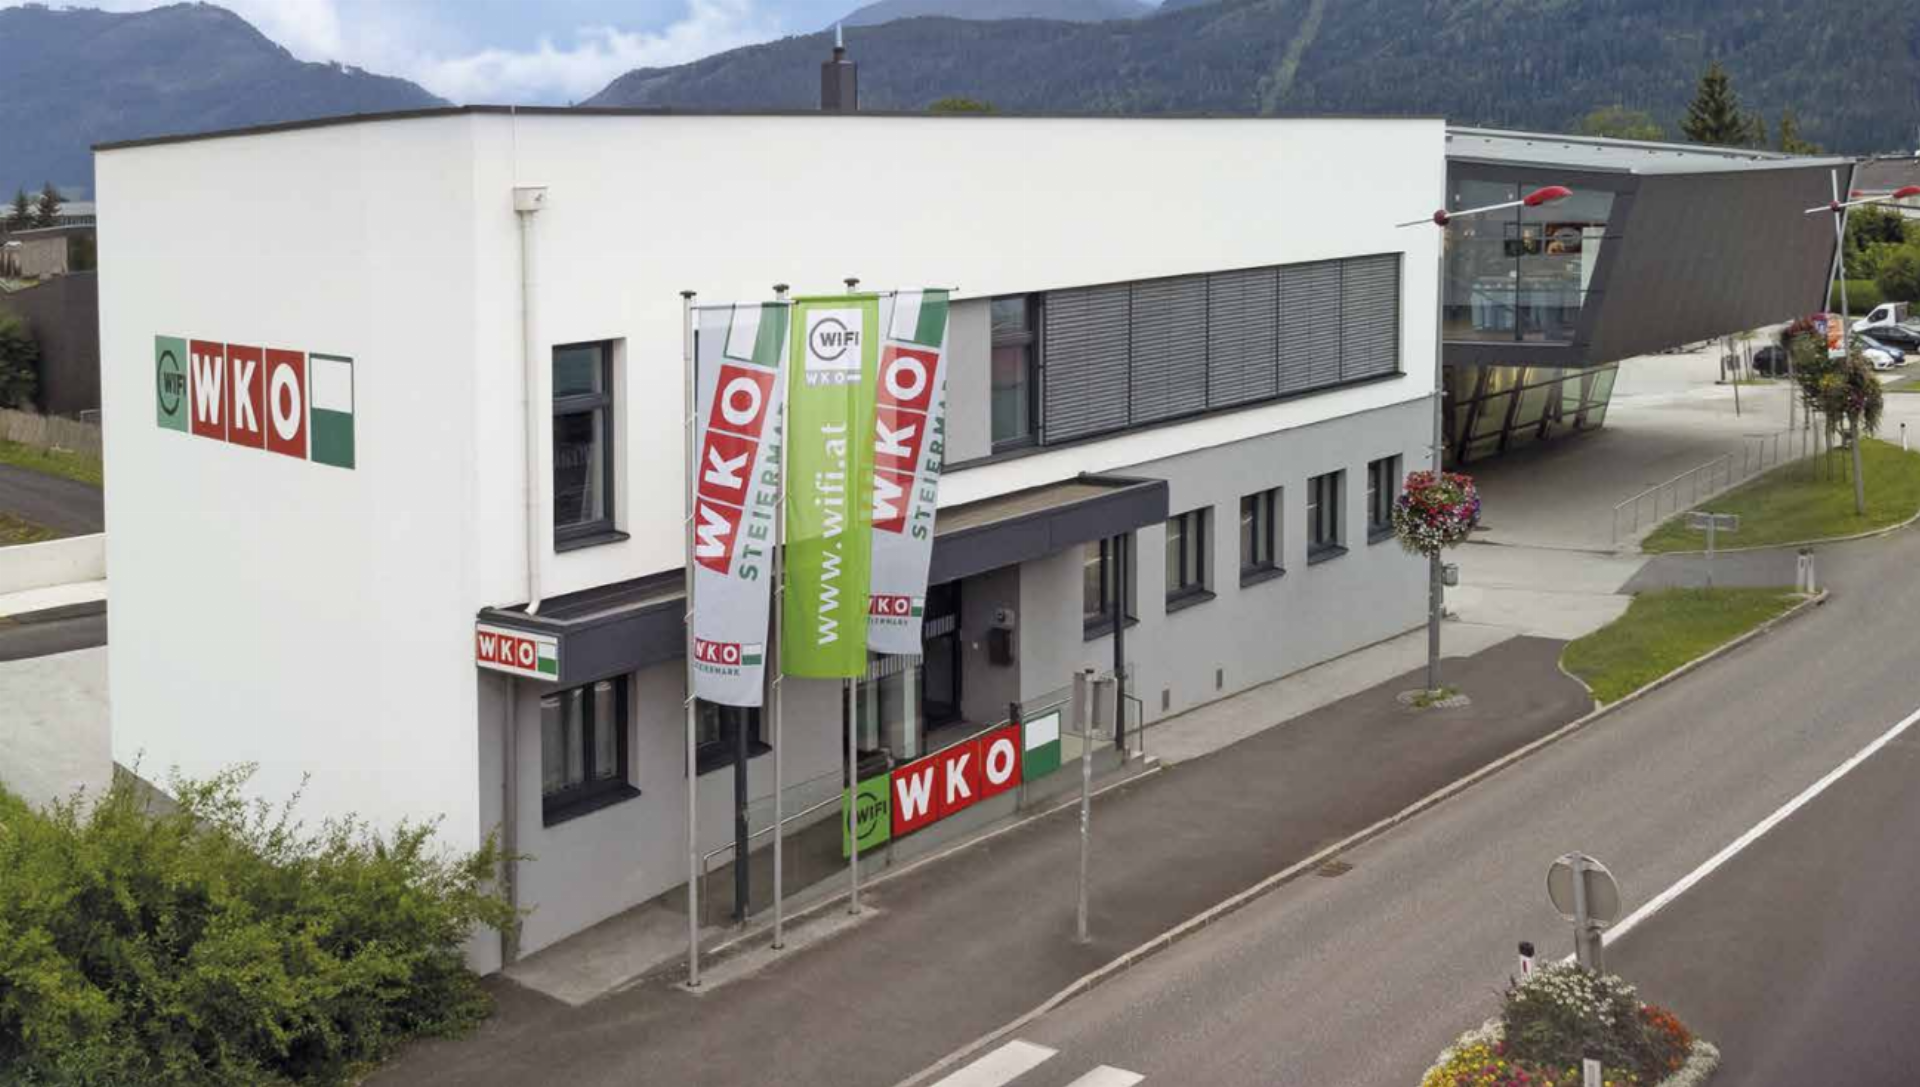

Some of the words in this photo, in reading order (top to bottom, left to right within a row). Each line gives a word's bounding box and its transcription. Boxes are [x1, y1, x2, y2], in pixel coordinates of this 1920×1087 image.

[191, 352, 301, 441] WKO
[820, 331, 859, 347] WIFI
[696, 376, 762, 558] WKO
[739, 401, 783, 581] STEIERM
[872, 357, 927, 520] WKO
[912, 380, 947, 541] STEIERM
[815, 421, 848, 645] www.wifi.at
[479, 634, 534, 665] WKO
[896, 738, 1016, 812] WKO
